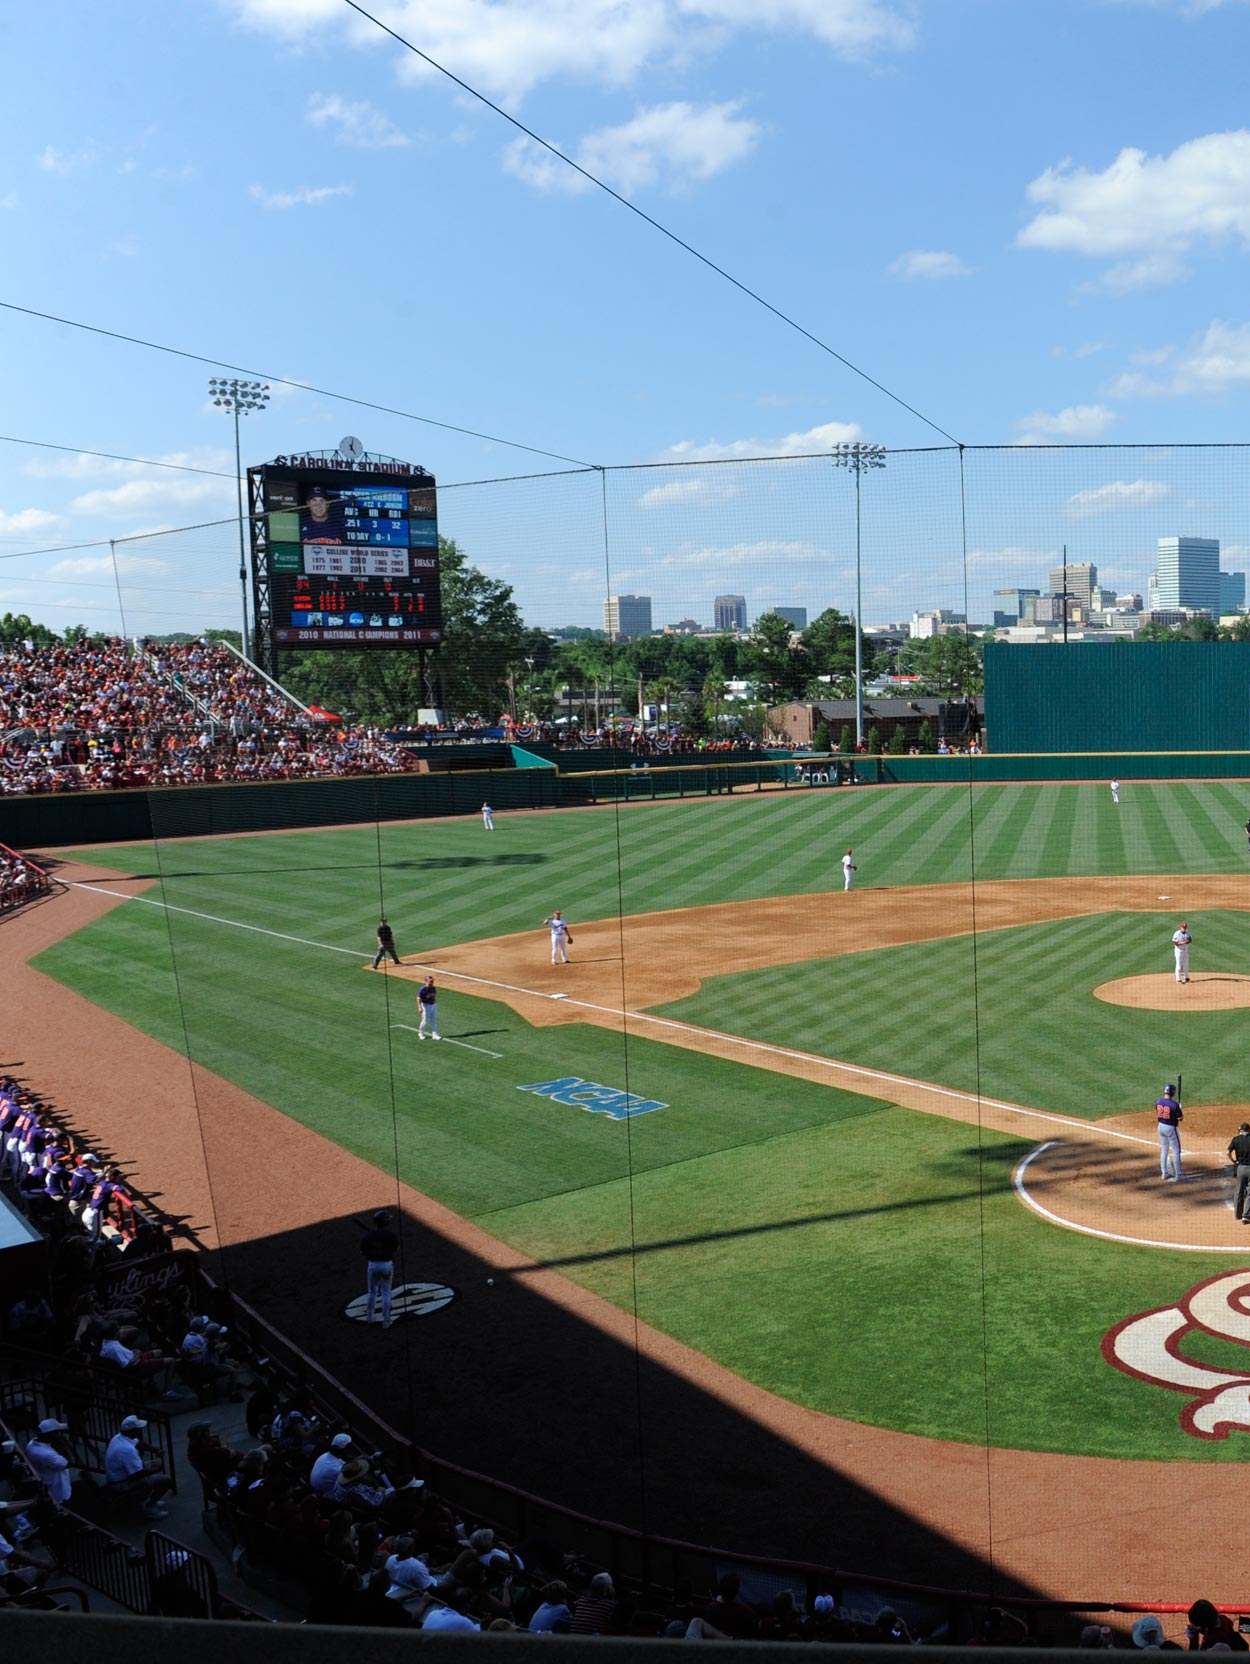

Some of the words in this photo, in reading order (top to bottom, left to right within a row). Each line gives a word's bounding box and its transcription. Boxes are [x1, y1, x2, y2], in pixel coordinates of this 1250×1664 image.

[290, 456, 353, 470] CAROLINA
[358, 462, 411, 476] STADIUM
[344, 507, 359, 516] AVG
[368, 508, 379, 517] HR
[388, 509, 401, 518] RBI
[372, 520, 378, 528] 3
[391, 521, 401, 530] 32
[346, 531, 370, 541] TODAY
[326, 548, 349, 556] COLLEGE
[350, 549, 369, 557] WORLD
[349, 556, 367, 565] 2010
[414, 558, 436, 568] BB&T
[350, 565, 366, 573] 2011
[298, 631, 319, 639] 2010
[323, 631, 355, 640] NATIONAL
[358, 631, 399, 640] CHAMPIONS
[403, 631, 422, 640] 2011
[515, 1076, 671, 1121] NCAA
[1156, 1104, 1171, 1120] 22
